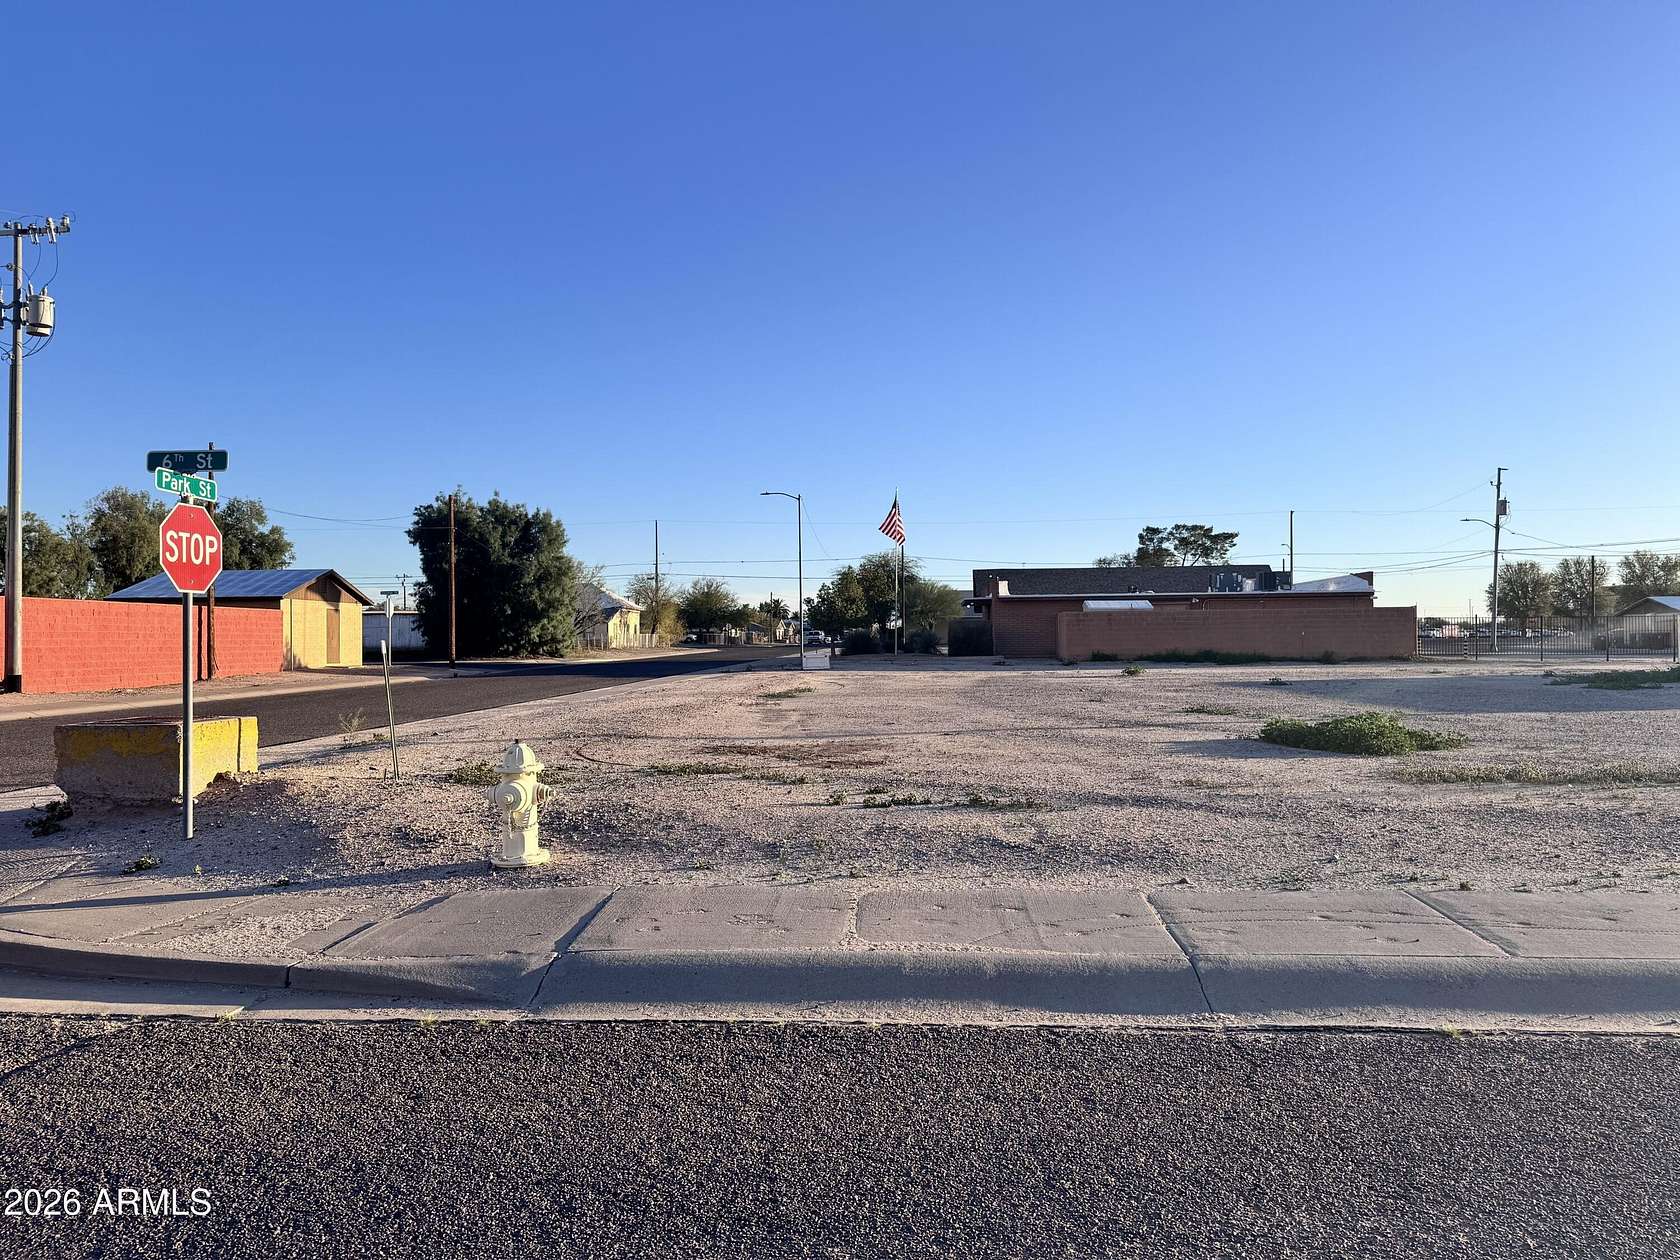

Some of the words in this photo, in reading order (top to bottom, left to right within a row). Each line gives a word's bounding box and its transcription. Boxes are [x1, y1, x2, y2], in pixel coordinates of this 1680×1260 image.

[196, 453, 213, 469] St
[161, 471, 191, 494] Park
[198, 482, 212, 498] St
[165, 529, 218, 566] STOP
